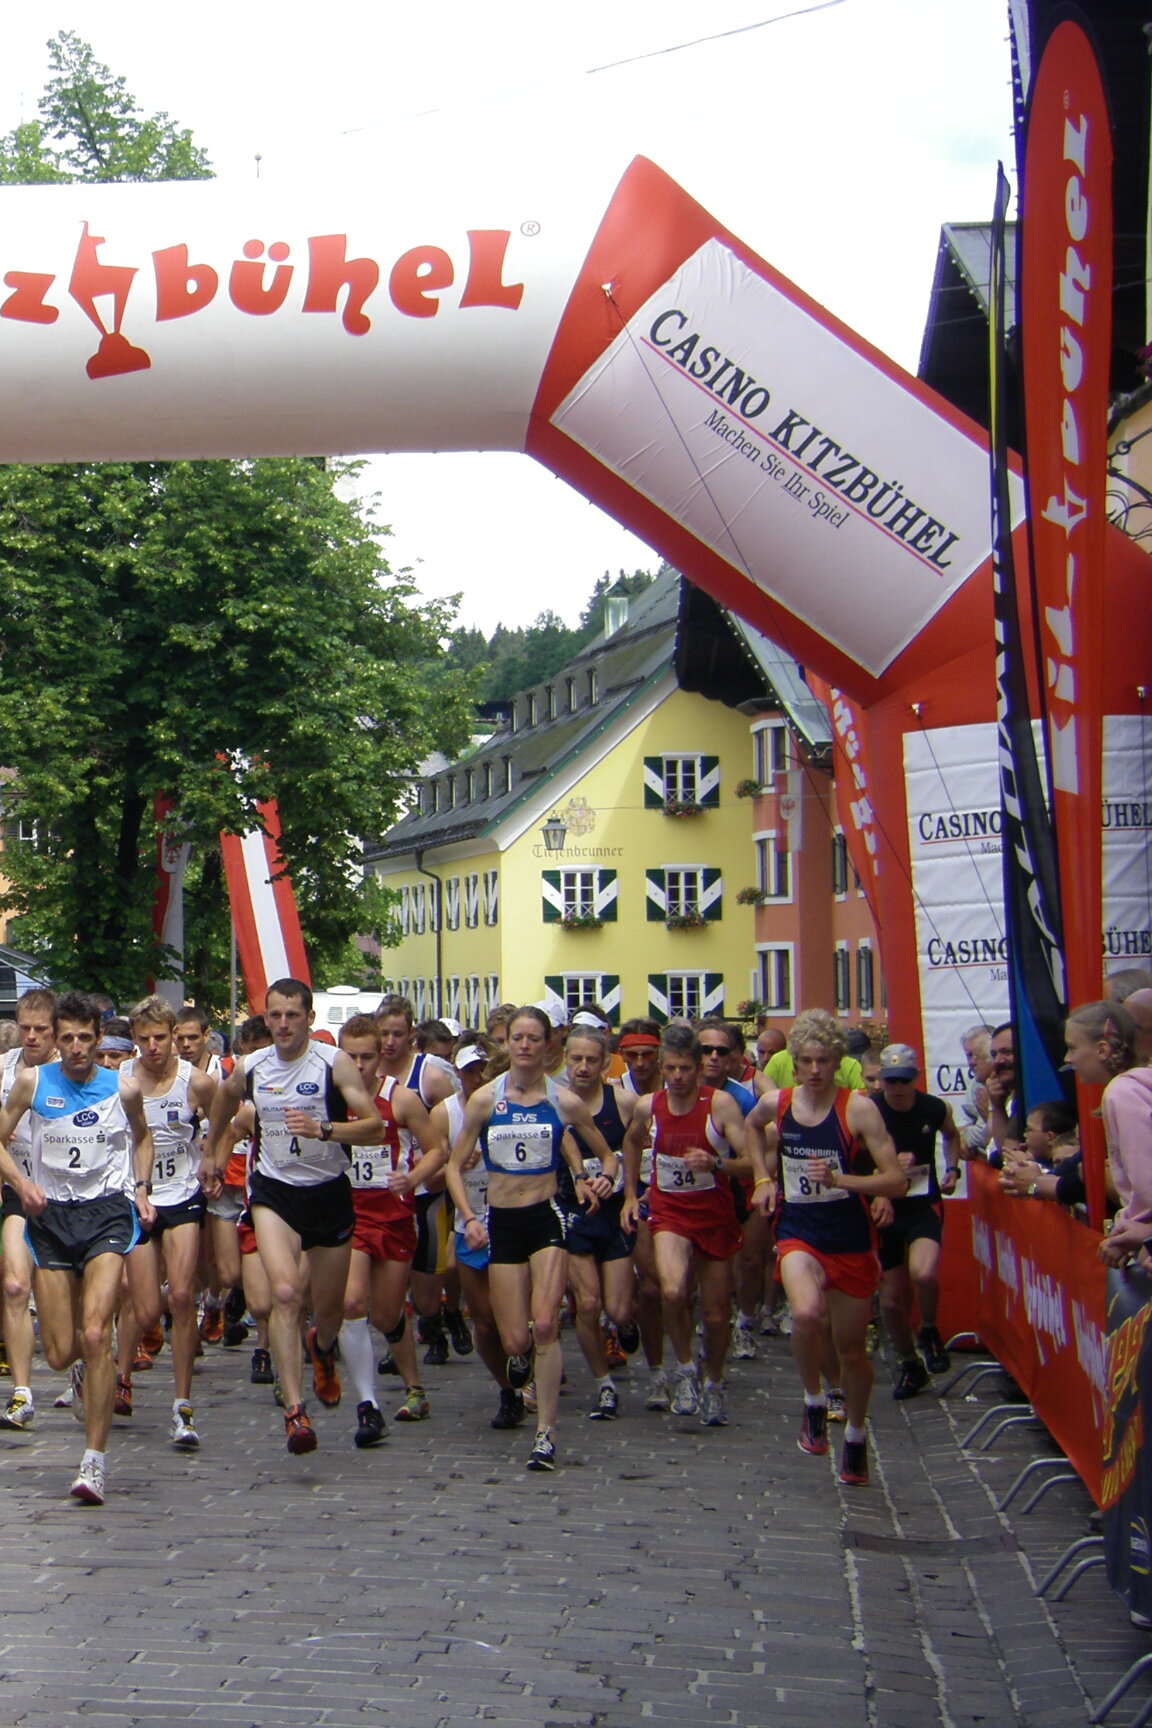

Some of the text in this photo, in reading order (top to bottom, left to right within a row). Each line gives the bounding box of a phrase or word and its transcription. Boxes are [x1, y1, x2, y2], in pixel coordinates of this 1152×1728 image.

[649, 308, 961, 571] CASINO KITZBÜHEL
[703, 408, 851, 530] Machen Sie Ihr Spiel
[299, 1083, 315, 1091] LCC
[75, 1111, 95, 1123] LCC
[512, 1113, 538, 1122] SVS
[265, 1127, 290, 1137] Spark
[490, 1131, 538, 1141] Sparkasse
[43, 1133, 94, 1144] Sparkasse
[11, 1147, 32, 1157] Spark
[289, 1136, 301, 1156] 4
[515, 1141, 527, 1162] 6
[793, 1146, 839, 1158] DORNBIRN
[68, 1146, 81, 1168] 2
[154, 1150, 176, 1159] asse
[155, 1158, 176, 1179] 15
[352, 1161, 373, 1181] 13
[672, 1170, 696, 1186] 34
